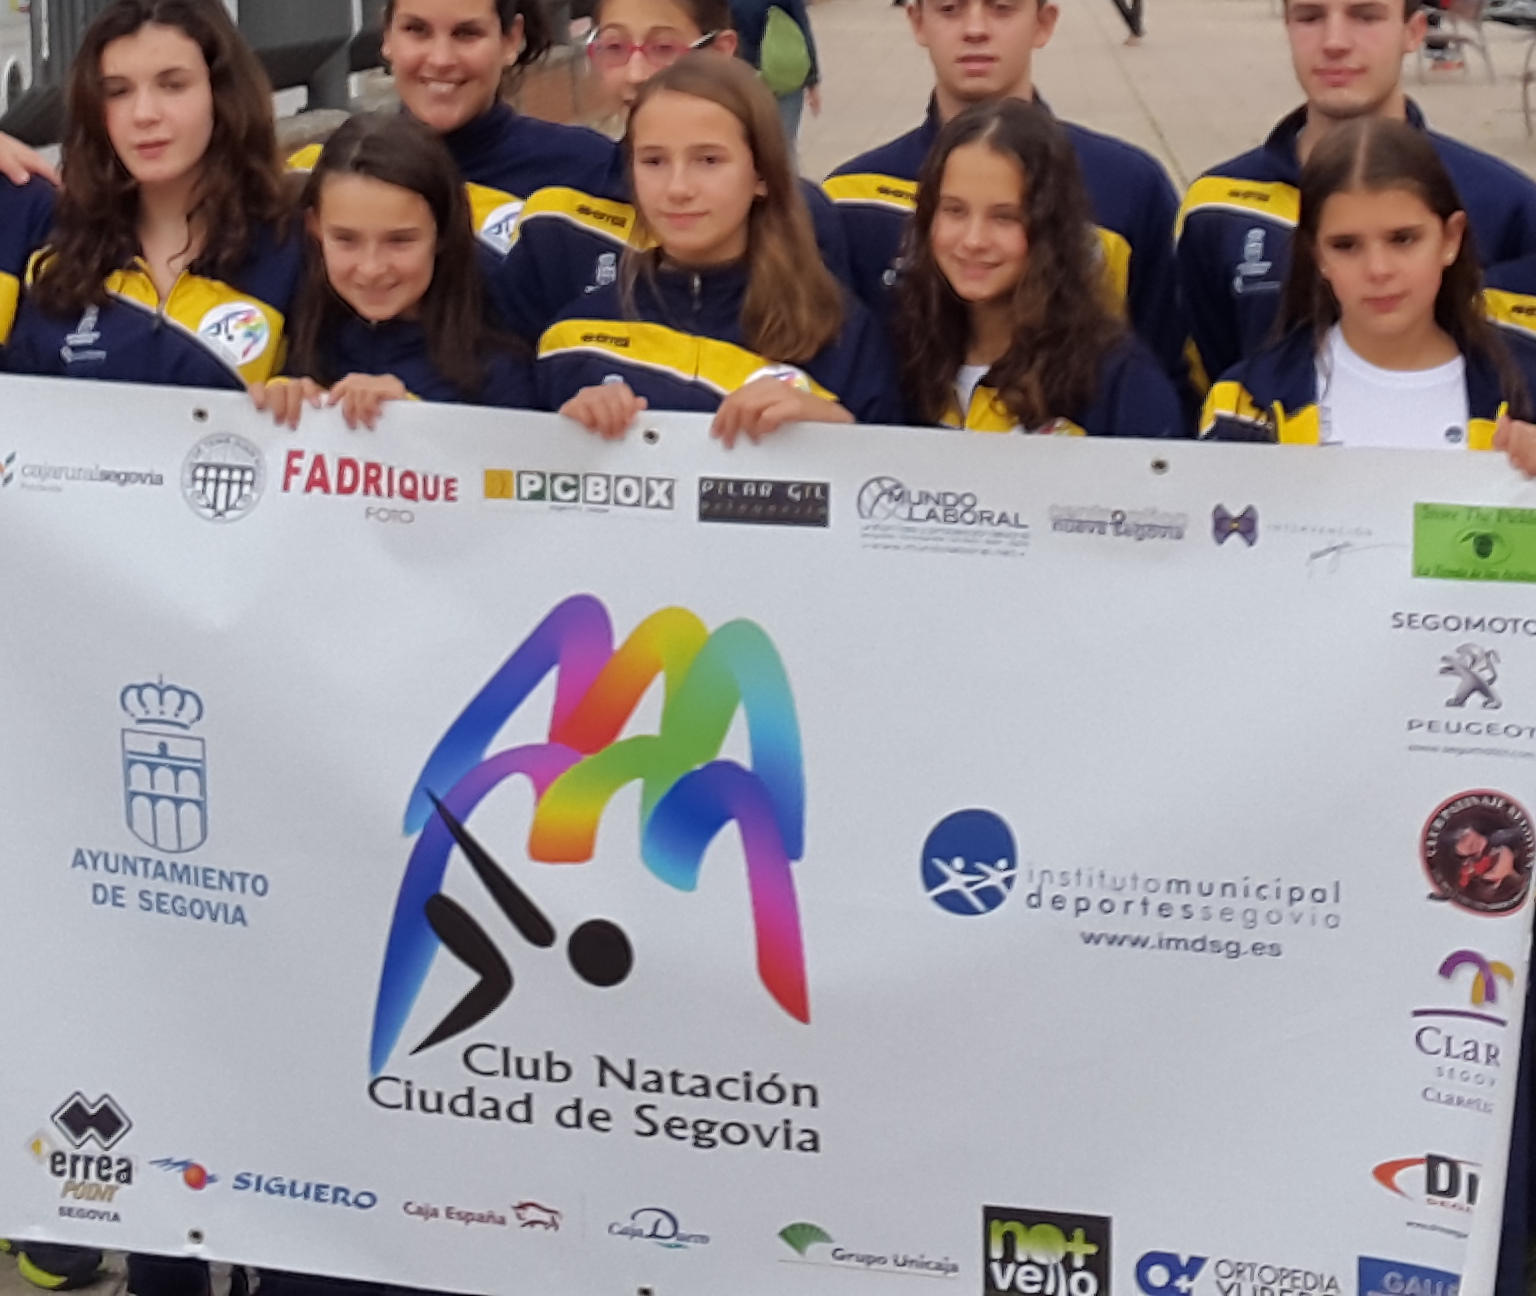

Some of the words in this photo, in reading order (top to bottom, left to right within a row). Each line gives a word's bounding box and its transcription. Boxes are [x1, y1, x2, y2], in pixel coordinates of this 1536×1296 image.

[281, 449, 459, 502] FADRIQUE
[518, 471, 674, 510] PCBOX
[886, 484, 977, 508] MUNDO
[364, 506, 415, 524] FOTO
[907, 507, 1030, 529] LABORAL
[70, 847, 271, 898] AYUNTAMIENTO
[91, 883, 126, 909] DE
[137, 887, 249, 928] SEGOVIA
[1080, 929, 1283, 960] www.imdsg.es
[461, 1042, 574, 1084] Club
[597, 1054, 820, 1109] Natación
[366, 1075, 534, 1125] Ciudad
[553, 1093, 615, 1134] de
[634, 1106, 821, 1156] Segovia
[232, 1170, 378, 1211] SIGUERO
[402, 1200, 441, 1222] Caja
[445, 1204, 508, 1229] España
[831, 1247, 889, 1267] Grupo
[892, 1252, 960, 1275] Unicaja
[1215, 1258, 1340, 1292] ORTOPEDIA
